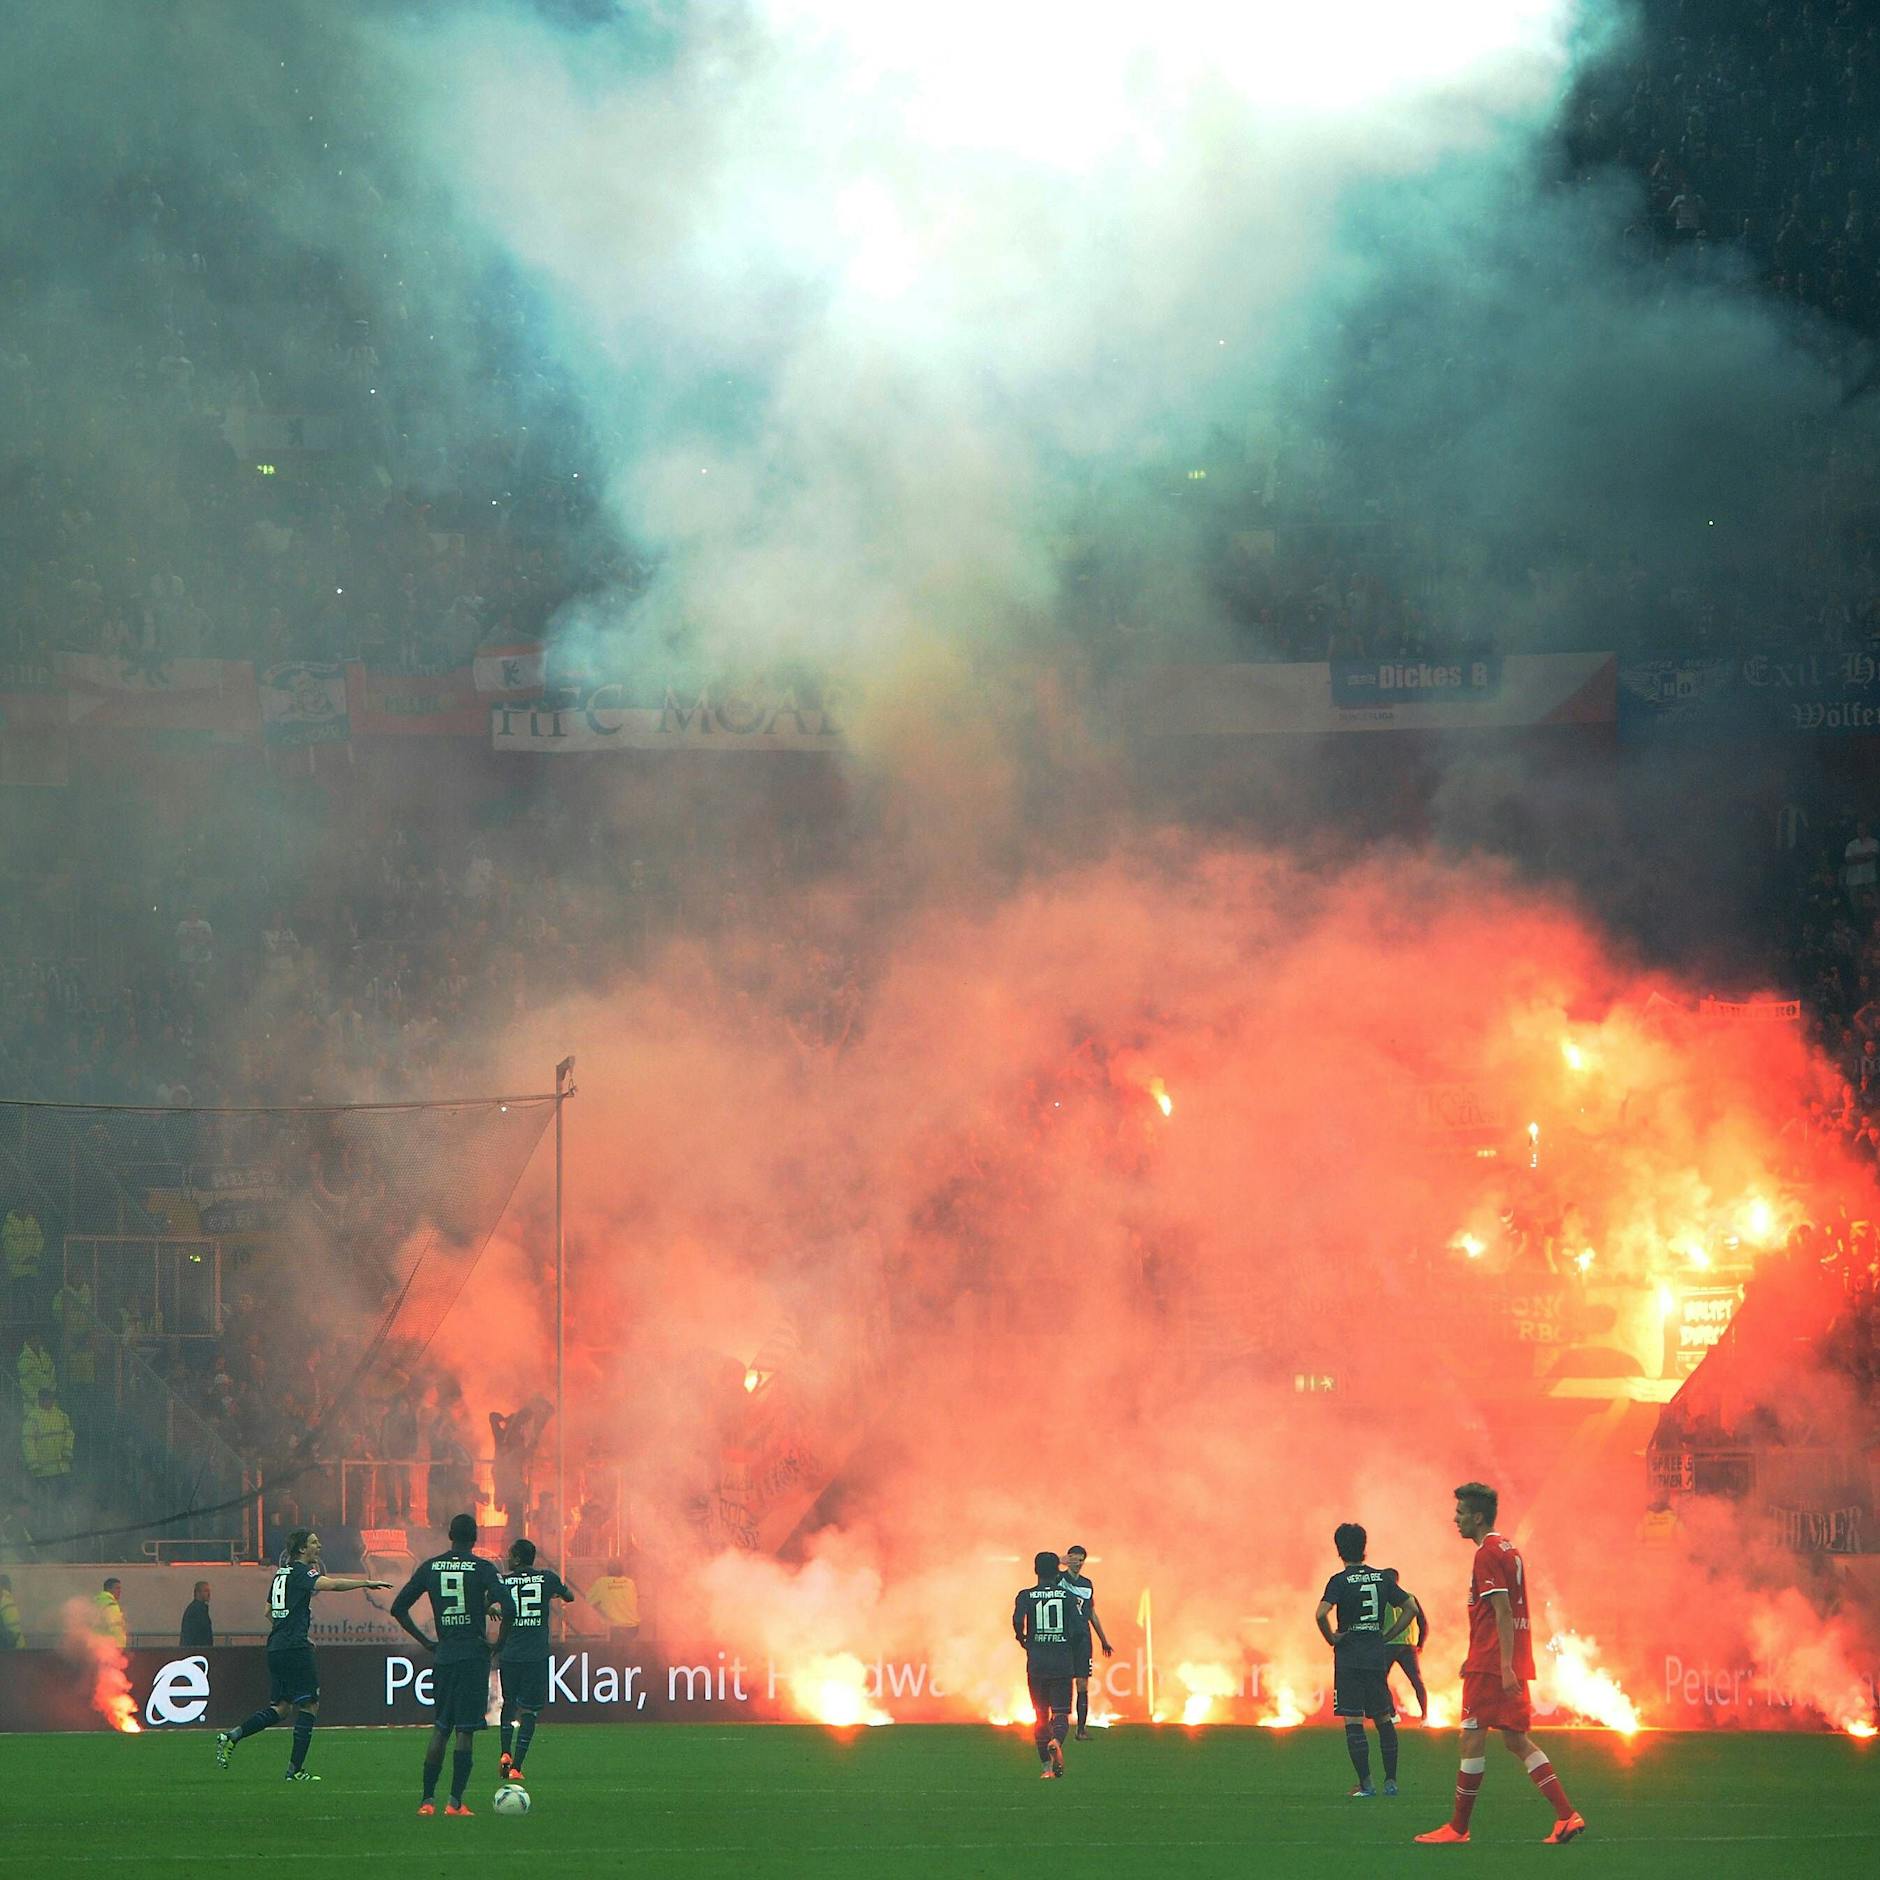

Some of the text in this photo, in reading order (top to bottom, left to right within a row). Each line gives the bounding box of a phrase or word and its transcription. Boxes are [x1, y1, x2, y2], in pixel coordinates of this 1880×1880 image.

[1379, 663, 1462, 689] Dickes
[440, 1572, 466, 1615] 9
[511, 1583, 542, 1617] 12
[1360, 1583, 1379, 1621] 3
[1035, 1598, 1064, 1633] 10
[548, 1652, 647, 1710] Klar,
[667, 1651, 748, 1700] mit
[1665, 1654, 1753, 1706] Peter:
